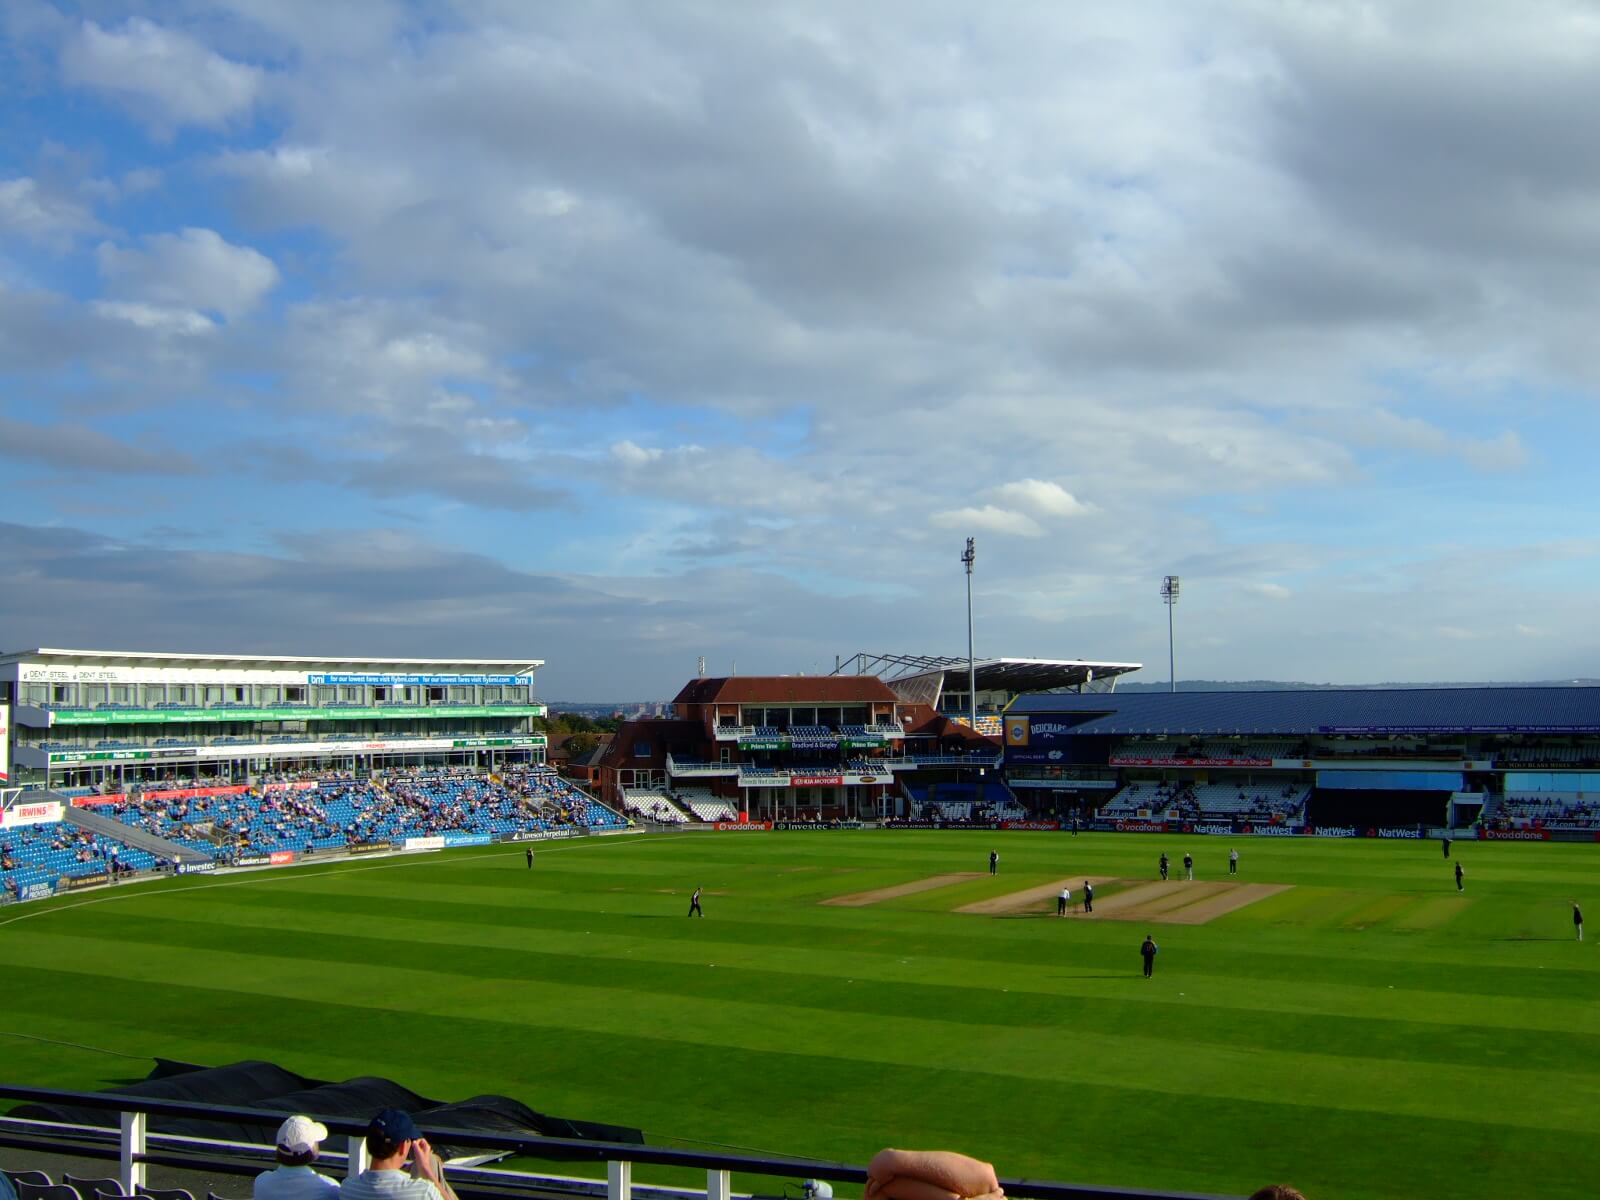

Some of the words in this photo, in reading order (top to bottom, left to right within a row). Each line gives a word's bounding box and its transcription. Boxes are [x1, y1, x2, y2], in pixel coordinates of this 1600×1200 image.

[311, 676, 324, 684] bmi
[515, 676, 528, 684] bmi
[20, 806, 46, 817] IRWINS
[1194, 825, 1232, 833] NatWest
[1253, 826, 1292, 834] NatWest
[1315, 826, 1355, 836] NatWest
[1378, 828, 1420, 838] NatWest
[522, 832, 542, 840] Invesco
[543, 829, 570, 838] Perpetual
[1496, 831, 1543, 839] vodafone
[187, 862, 215, 872] Investec
